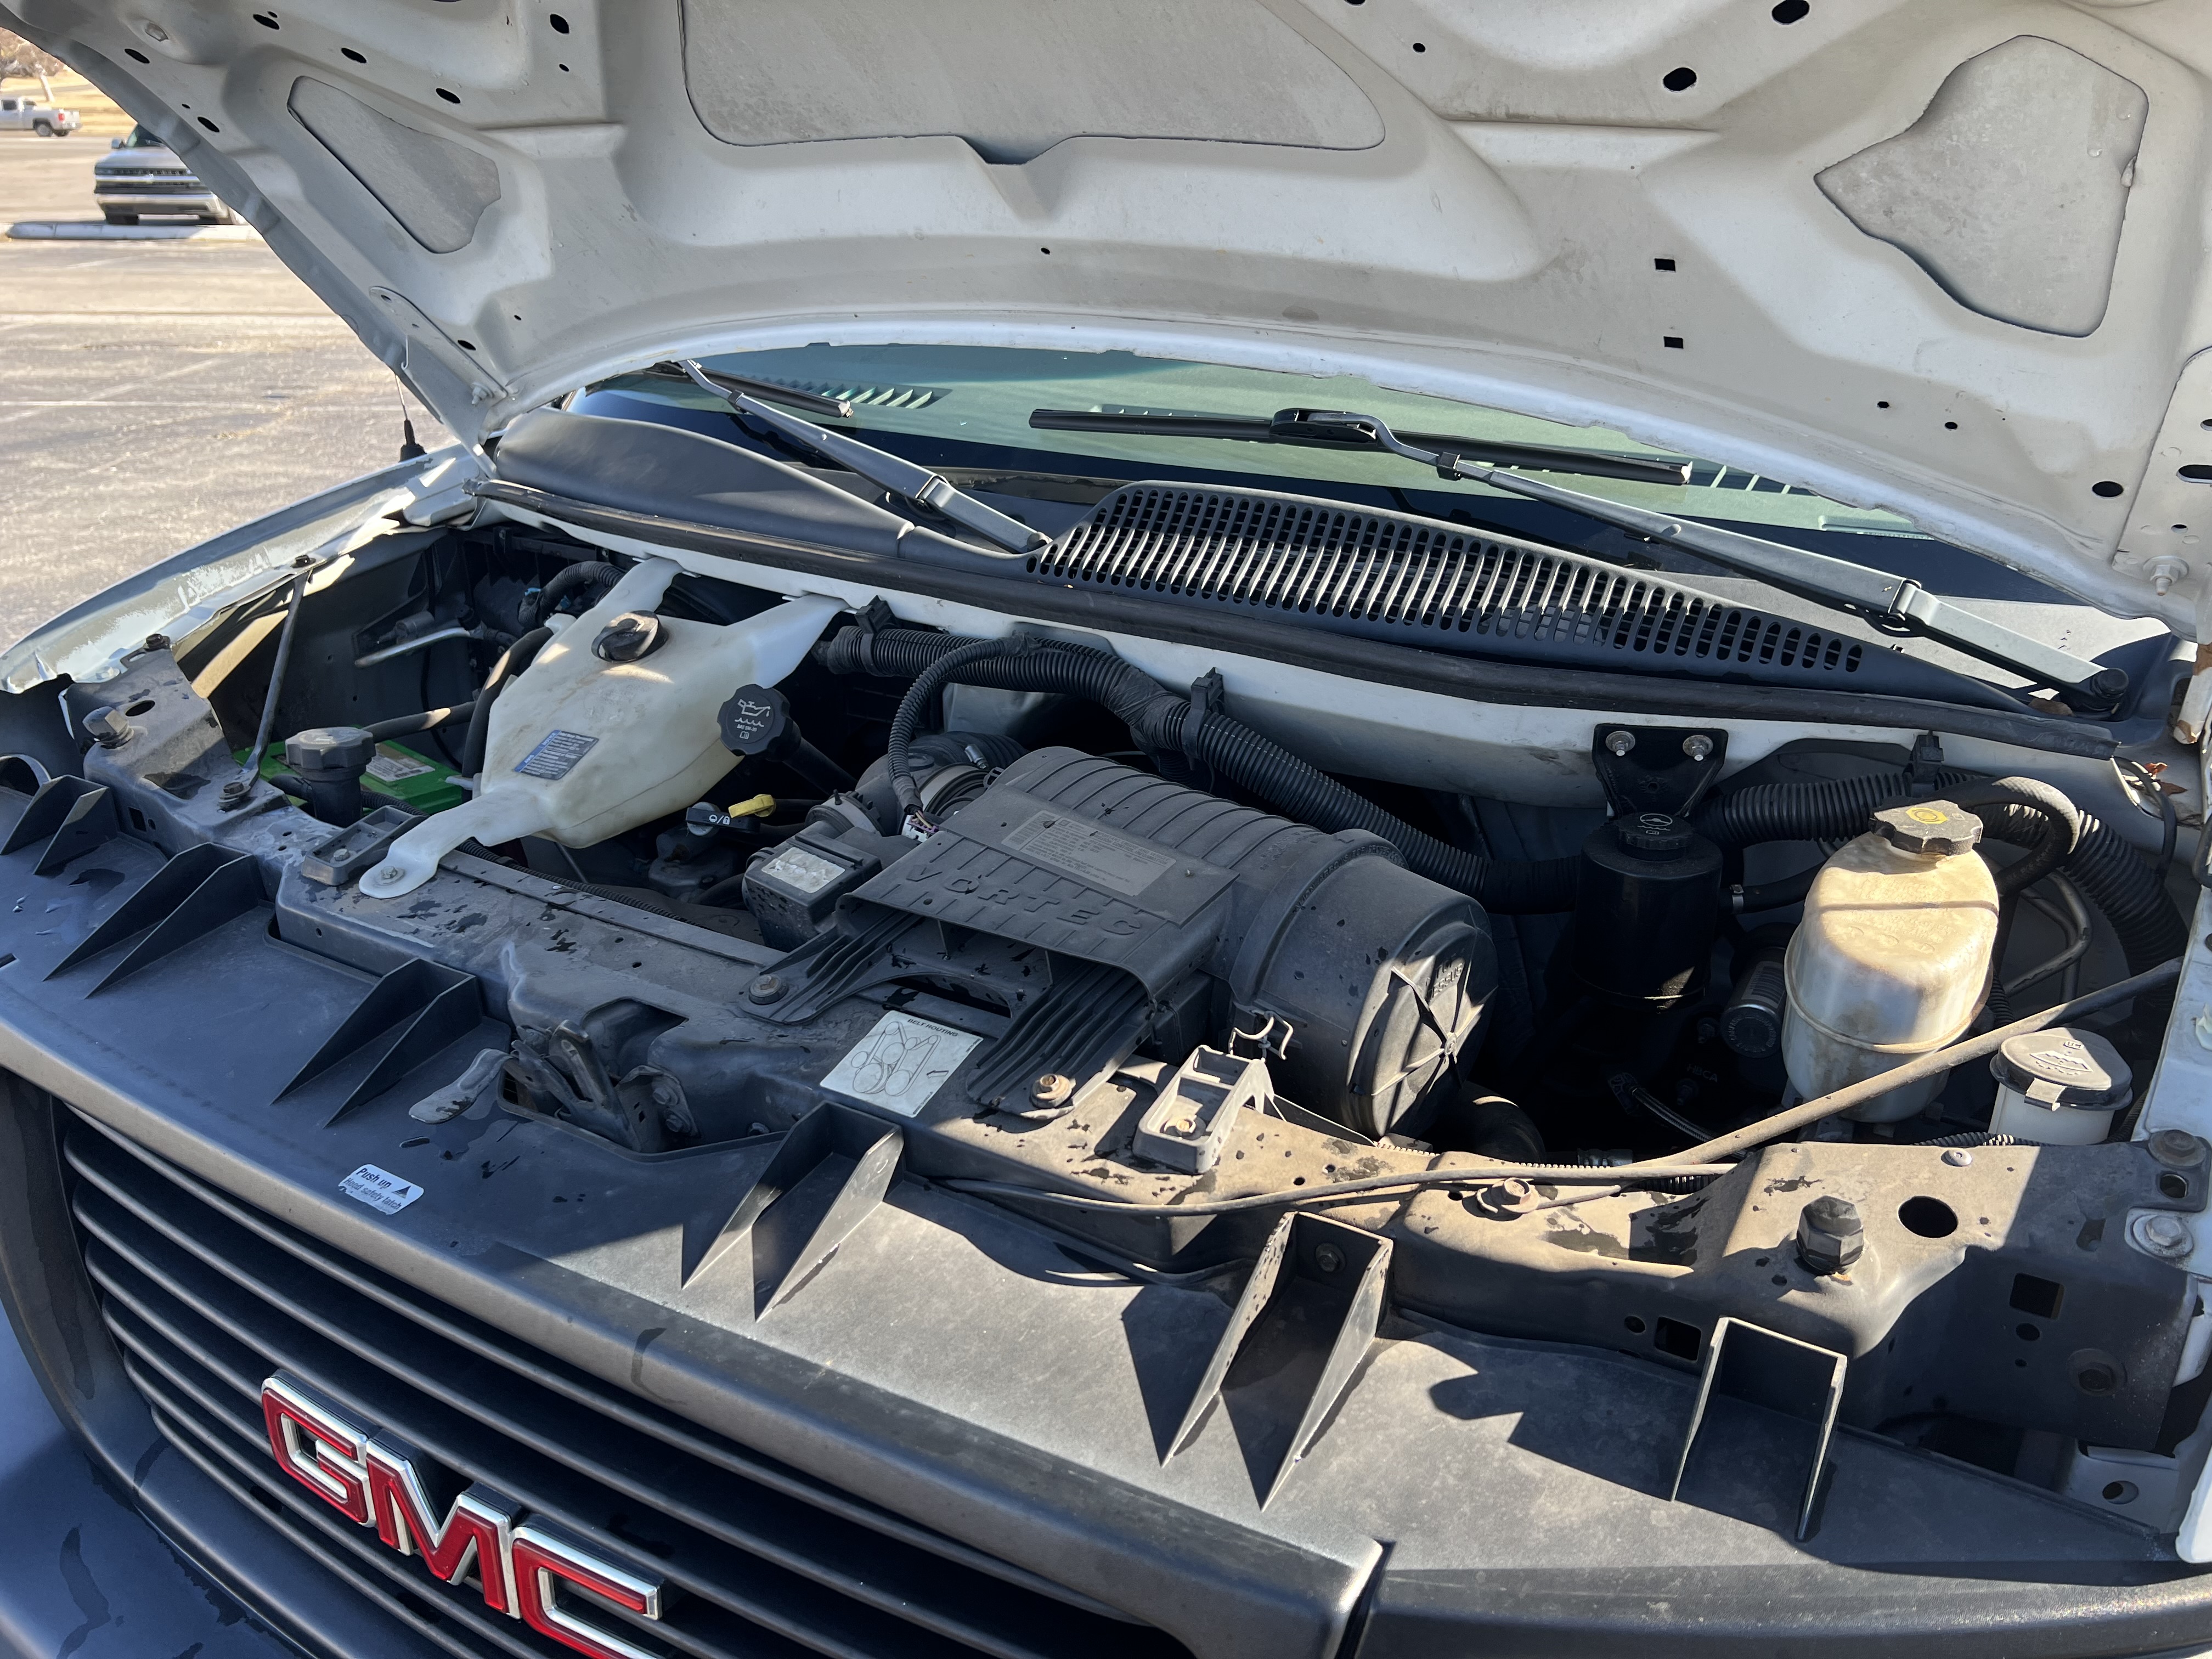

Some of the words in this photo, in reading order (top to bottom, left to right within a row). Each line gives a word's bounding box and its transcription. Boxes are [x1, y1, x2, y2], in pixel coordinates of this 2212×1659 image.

[1111, 841, 1135, 852] CONTROL
[1133, 850, 1169, 865] INFORMATION
[906, 865, 1141, 935] VORTEC
[926, 1024, 959, 1037] ROUTING
[356, 1167, 380, 1183] Push
[377, 1179, 392, 1189] up
[343, 1177, 364, 1190] Hood
[360, 1187, 384, 1201] safety
[381, 1196, 402, 1210] latch
[261, 1374, 664, 1659] GMC
